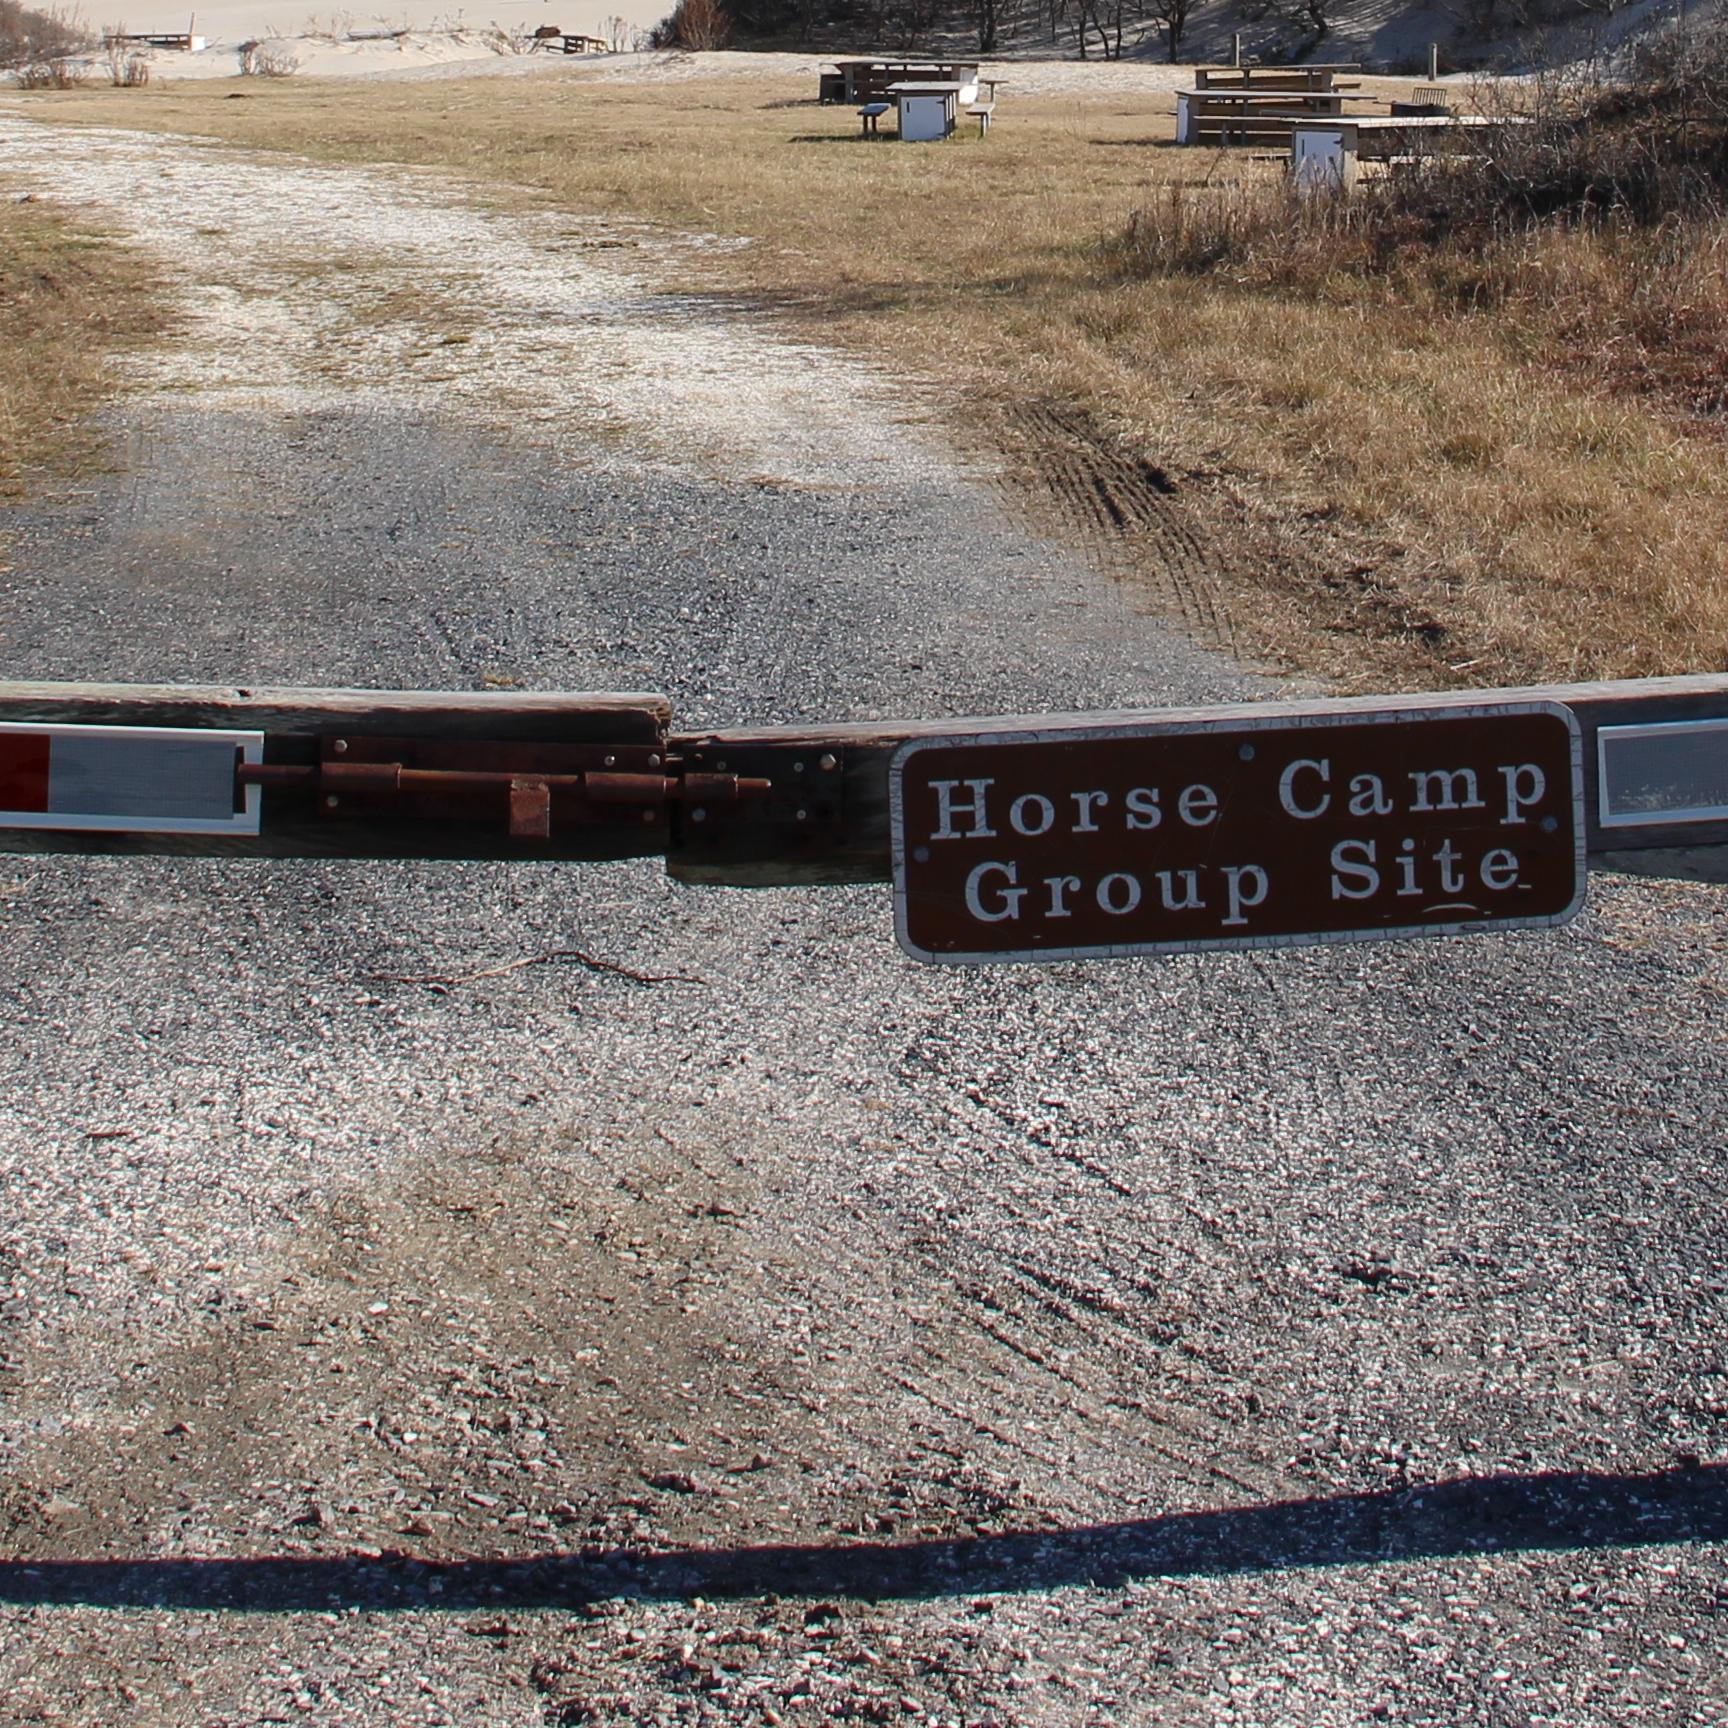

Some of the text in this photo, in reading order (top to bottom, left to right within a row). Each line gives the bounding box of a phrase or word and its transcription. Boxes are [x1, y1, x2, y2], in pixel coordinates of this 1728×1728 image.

[928, 758, 1548, 841] Horse Camp
[964, 838, 1521, 927] Group Site
